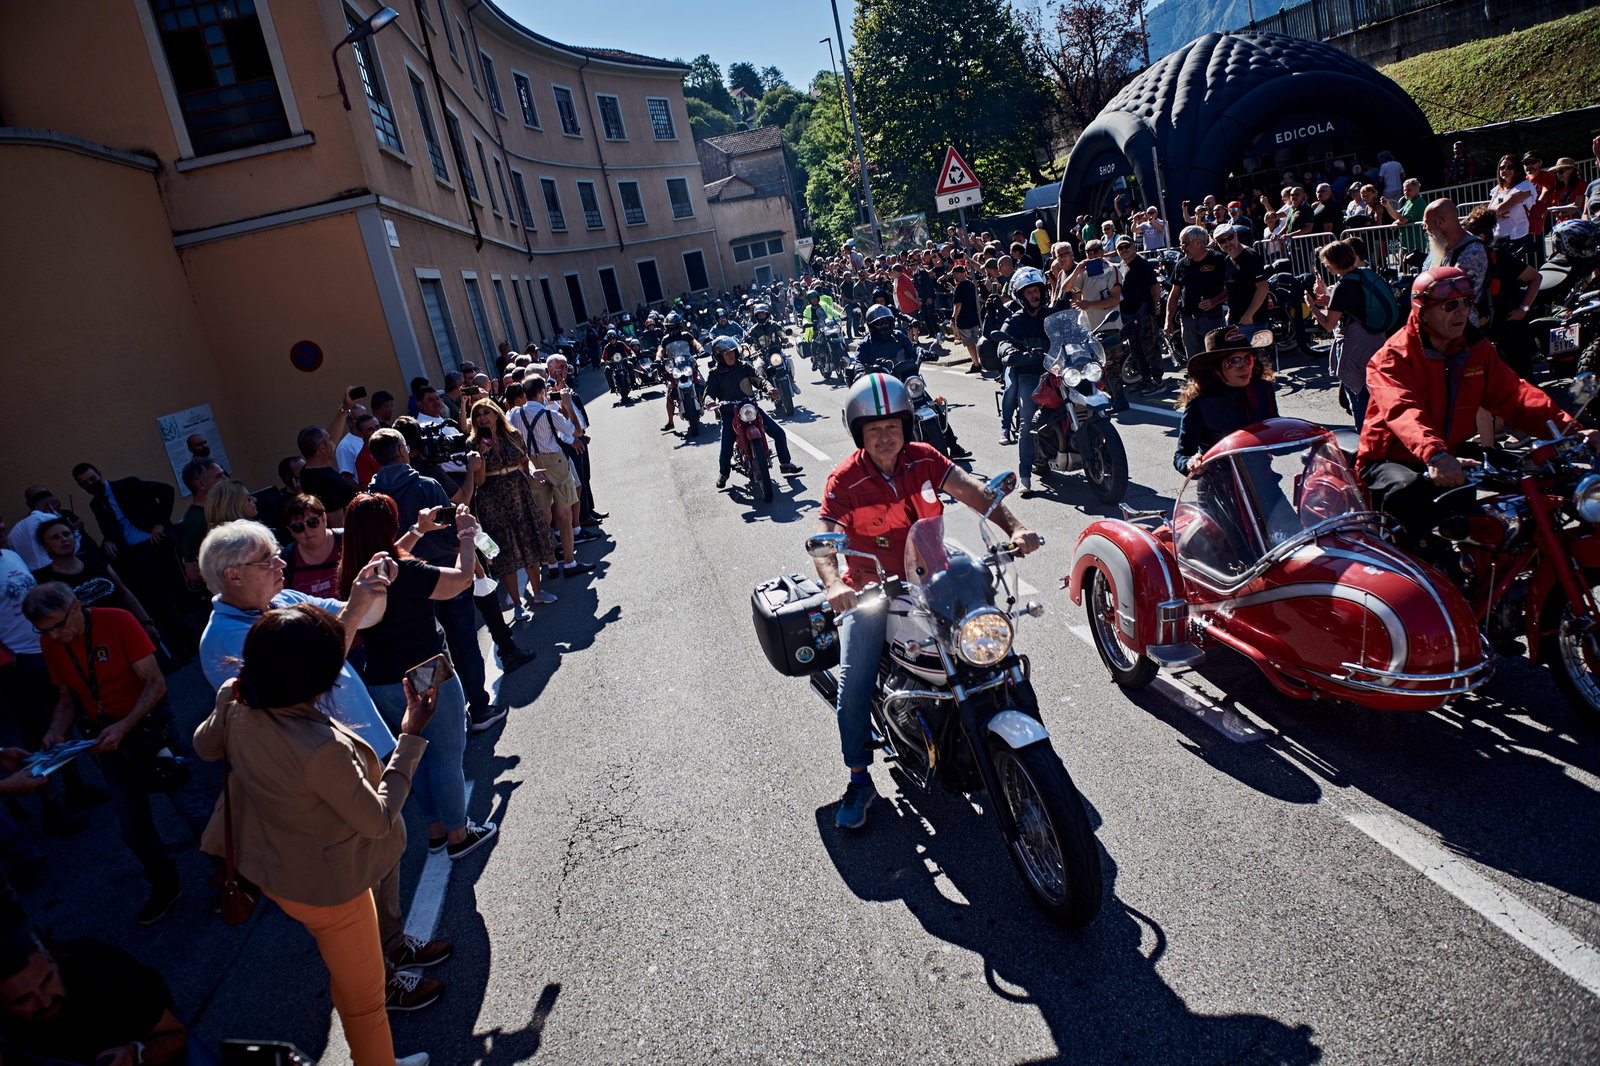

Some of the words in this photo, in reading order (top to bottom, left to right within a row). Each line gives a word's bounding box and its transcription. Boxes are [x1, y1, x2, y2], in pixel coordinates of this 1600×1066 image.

[1275, 121, 1335, 144] EDICOLA
[1099, 163, 1115, 175] SHOP
[948, 196, 960, 205] 80
